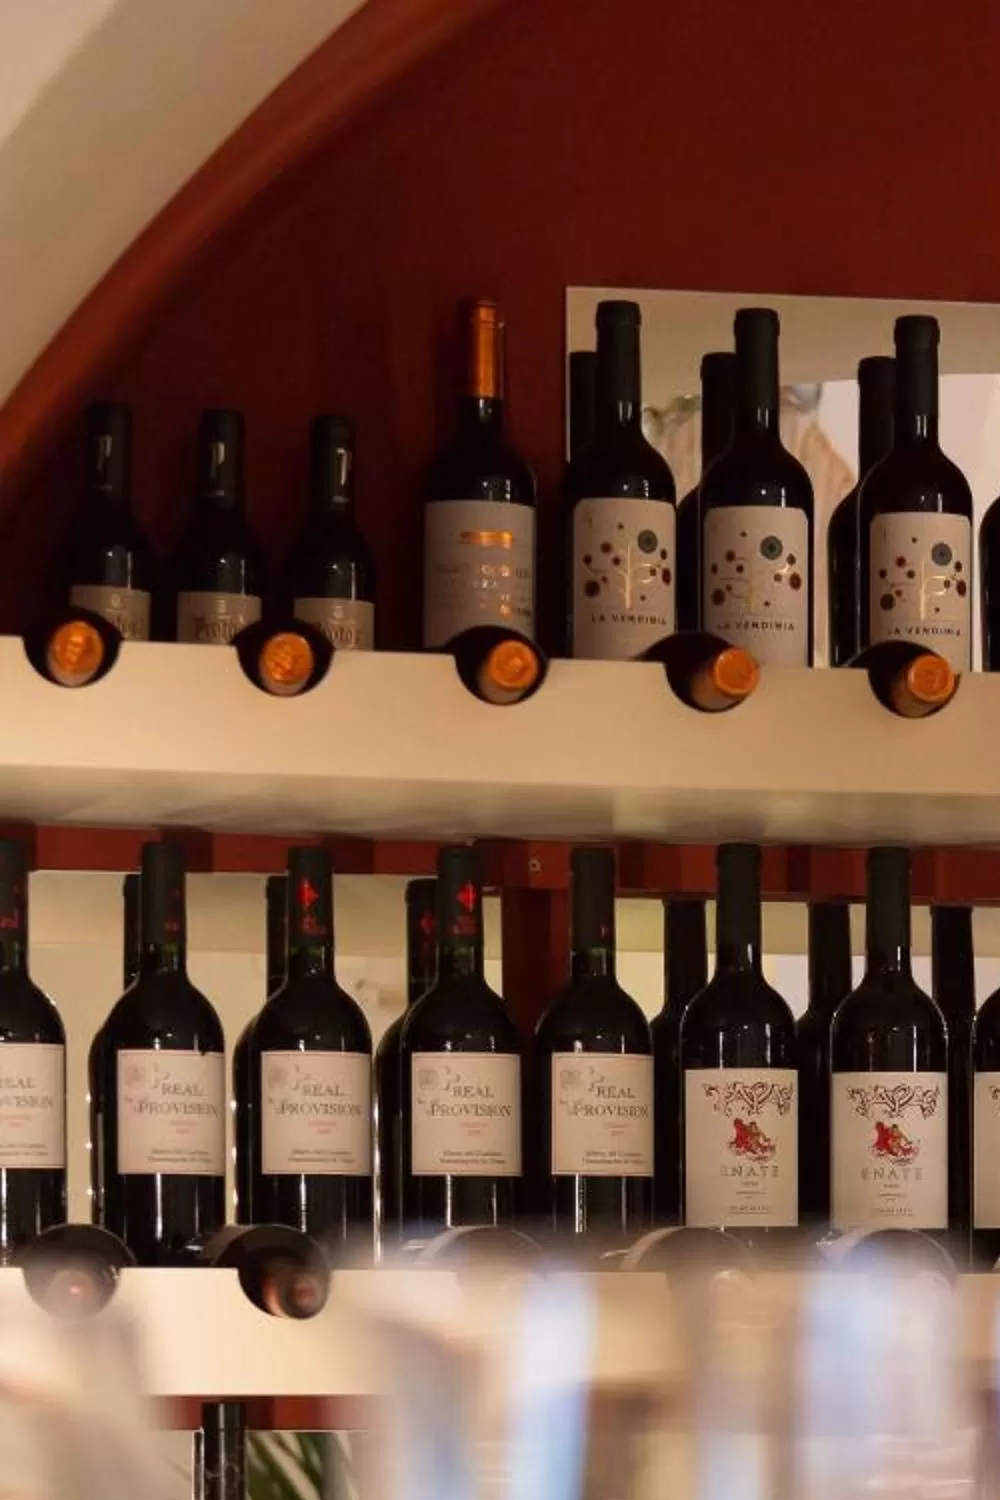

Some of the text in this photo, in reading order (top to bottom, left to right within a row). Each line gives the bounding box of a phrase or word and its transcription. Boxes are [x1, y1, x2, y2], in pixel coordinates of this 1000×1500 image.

[162, 1083, 205, 1096] REAL
[301, 1083, 344, 1097] REAL
[452, 1085, 495, 1098] REAL
[594, 1085, 636, 1098] REAL
[138, 1102, 221, 1118] PROVISION
[279, 1102, 362, 1117] PROVISION
[429, 1103, 513, 1118] PROVISION
[573, 1103, 650, 1118] PROVISION
[720, 1166, 780, 1178] ENATE
[861, 1167, 924, 1181] ENATE
